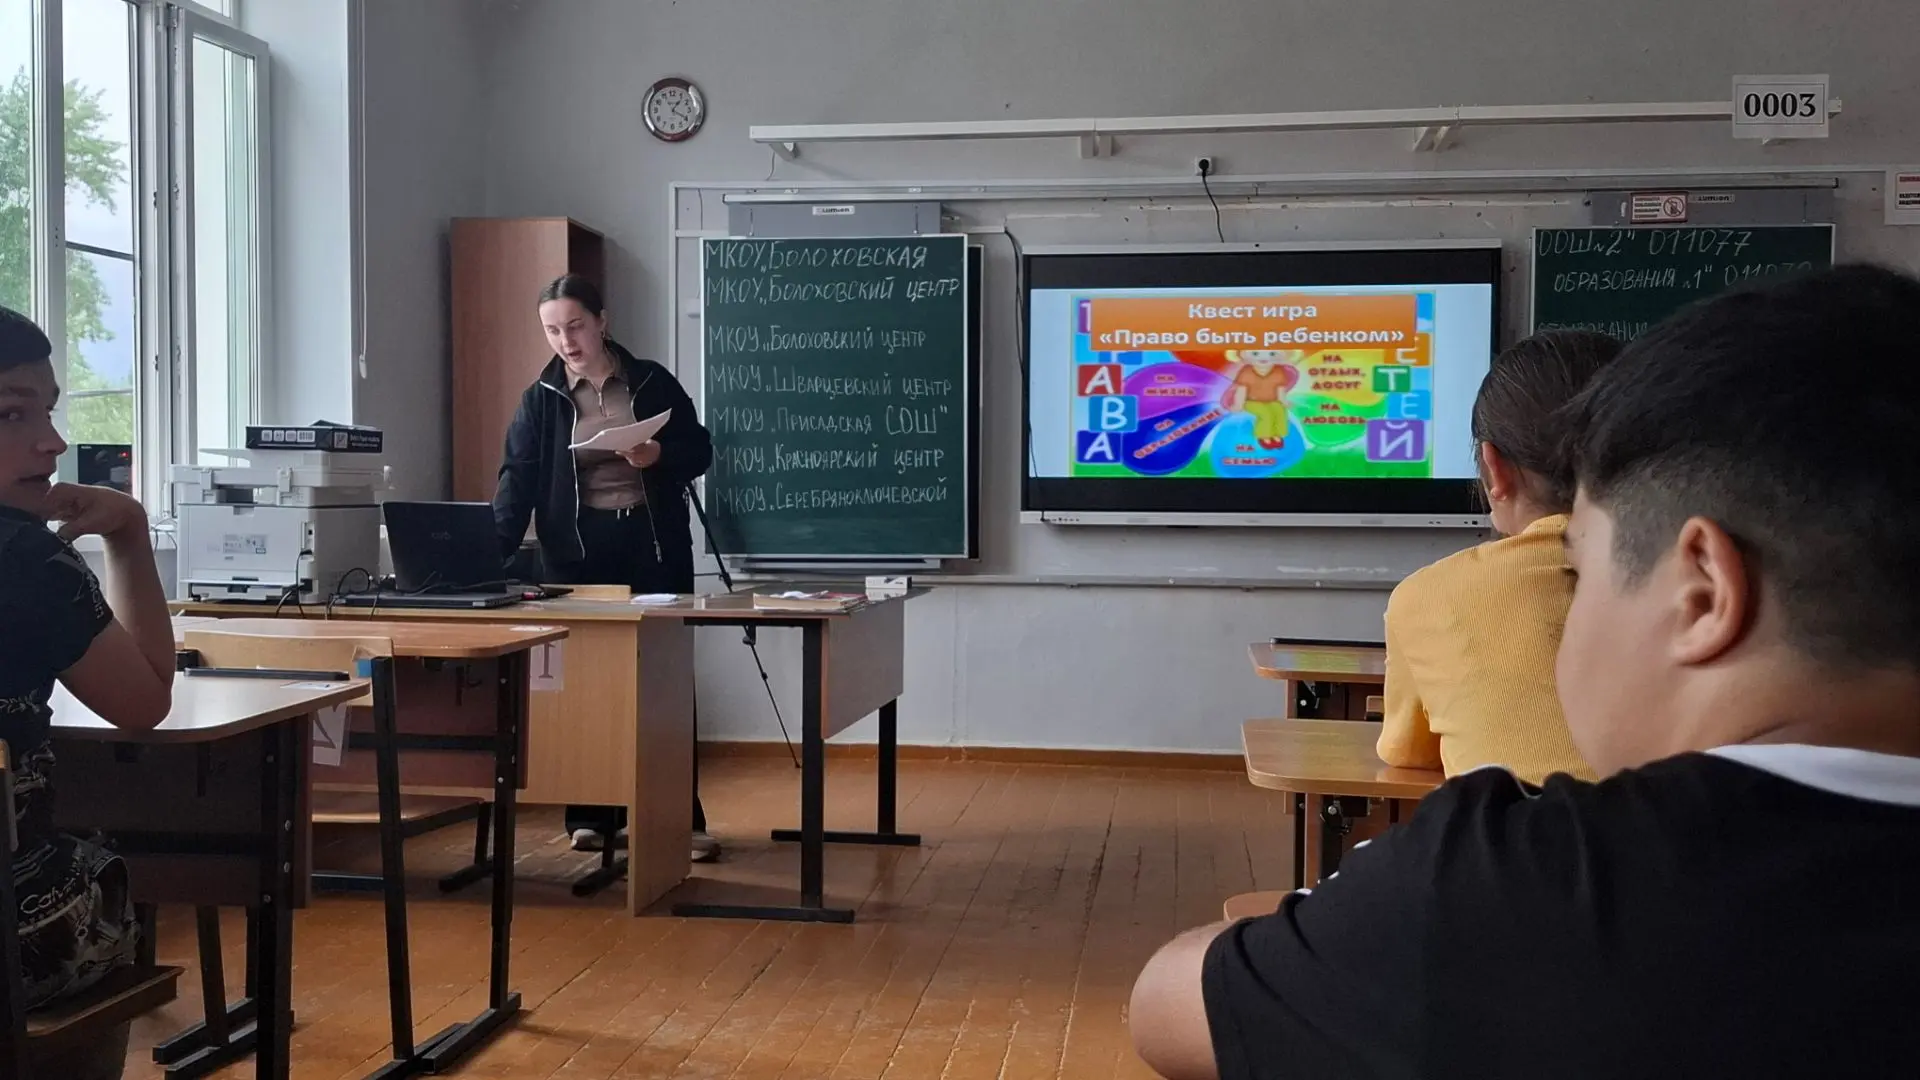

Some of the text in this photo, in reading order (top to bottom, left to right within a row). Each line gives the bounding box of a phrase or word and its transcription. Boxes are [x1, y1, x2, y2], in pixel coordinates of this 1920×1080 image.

[1744, 93, 1816, 118] 0003
[705, 241, 766, 272] МКОУ
[706, 275, 764, 306] МКОУ
[906, 278, 960, 302] ЦЕНТР
[1188, 303, 1318, 321] Квест игра
[708, 324, 760, 355] МКОУ
[881, 331, 927, 354] ЦЕНТР
[1100, 327, 1405, 348] «Право быть ребенком»
[709, 363, 762, 394] МКОУ
[902, 378, 952, 400] ЦЕНТР
[712, 407, 764, 437] МКОУ
[712, 444, 764, 477] МКОУ
[894, 448, 945, 474] ЦЕНТР
[714, 483, 767, 519] МКОУ
